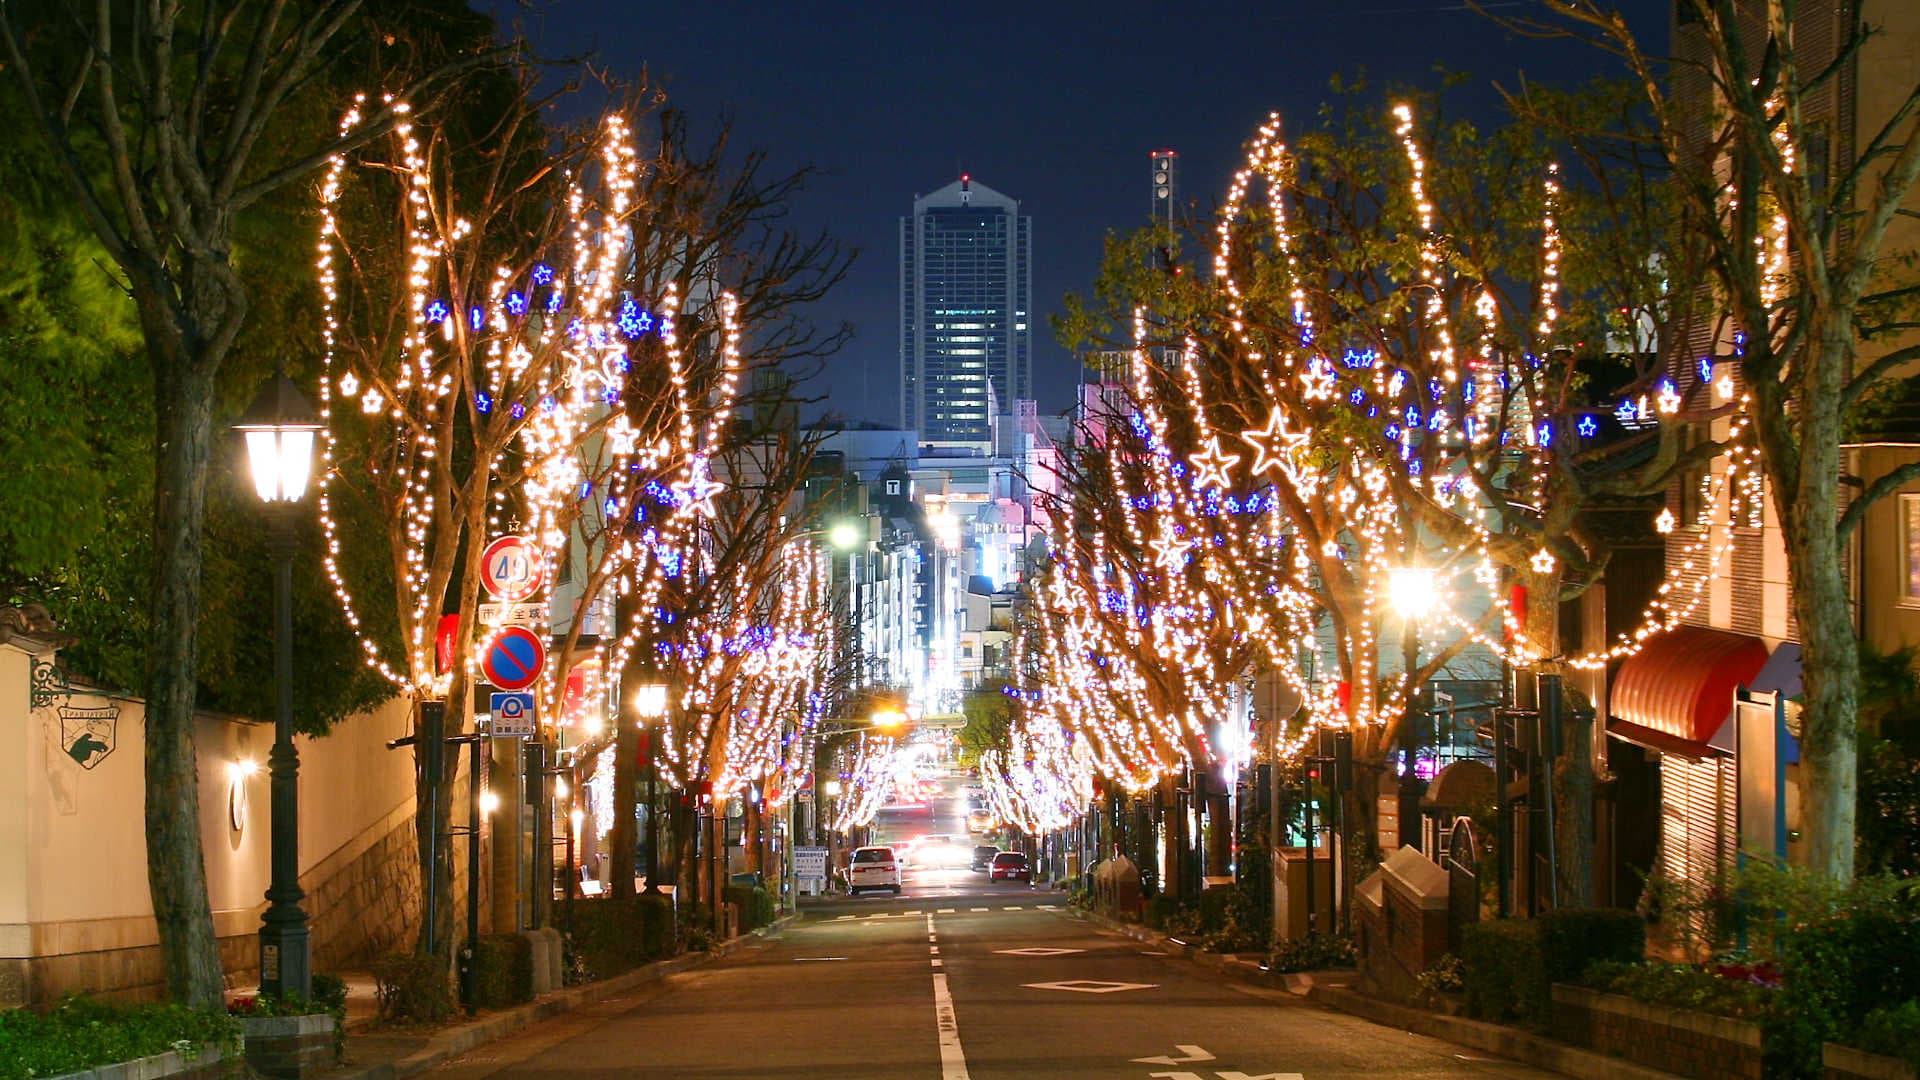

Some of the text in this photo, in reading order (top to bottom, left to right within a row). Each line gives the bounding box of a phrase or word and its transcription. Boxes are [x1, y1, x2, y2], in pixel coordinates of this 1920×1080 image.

[495, 555, 528, 582] 40
[481, 608, 541, 619] 市全域
